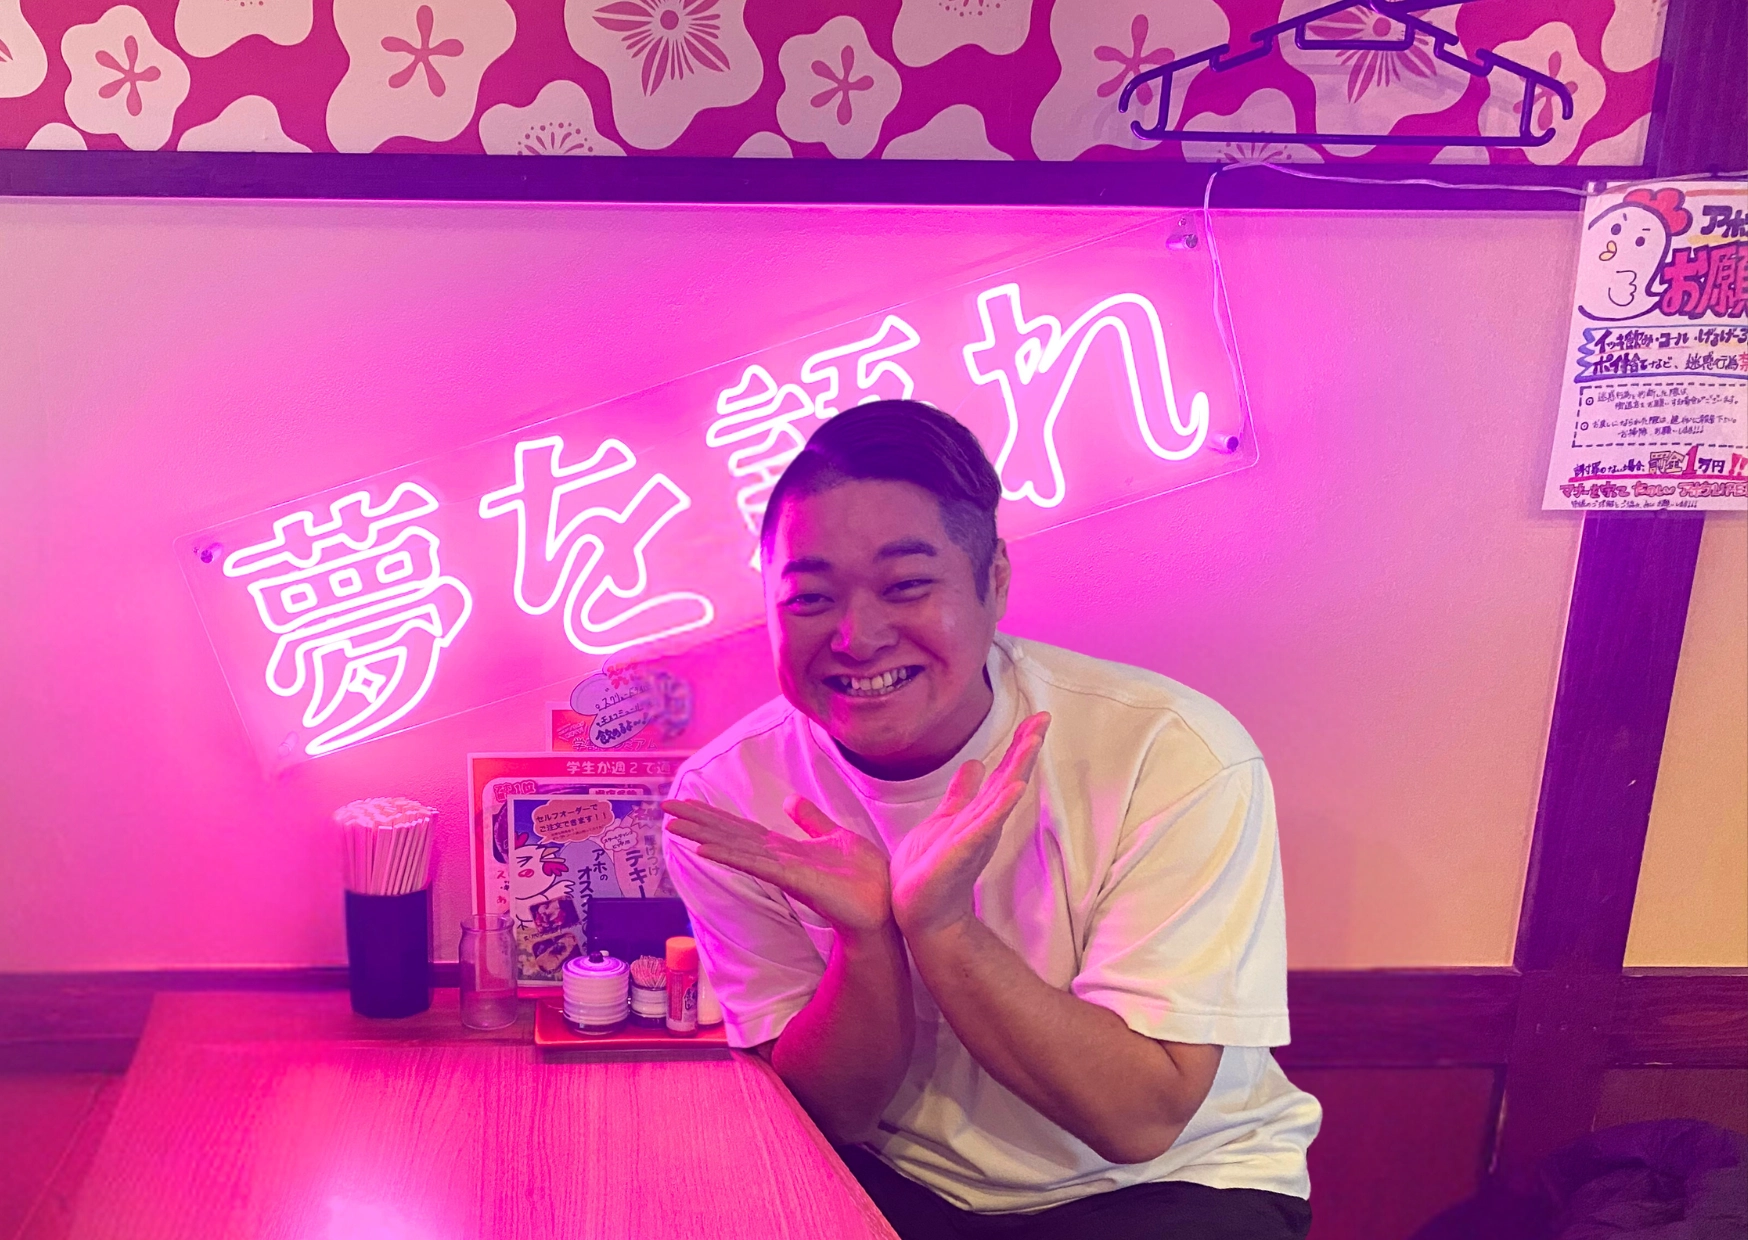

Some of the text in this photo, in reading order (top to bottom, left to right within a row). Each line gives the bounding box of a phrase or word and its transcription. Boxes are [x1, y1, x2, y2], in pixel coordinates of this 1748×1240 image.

[1700, 205, 1748, 238] アホ
[644, 834, 660, 876] けつけ
